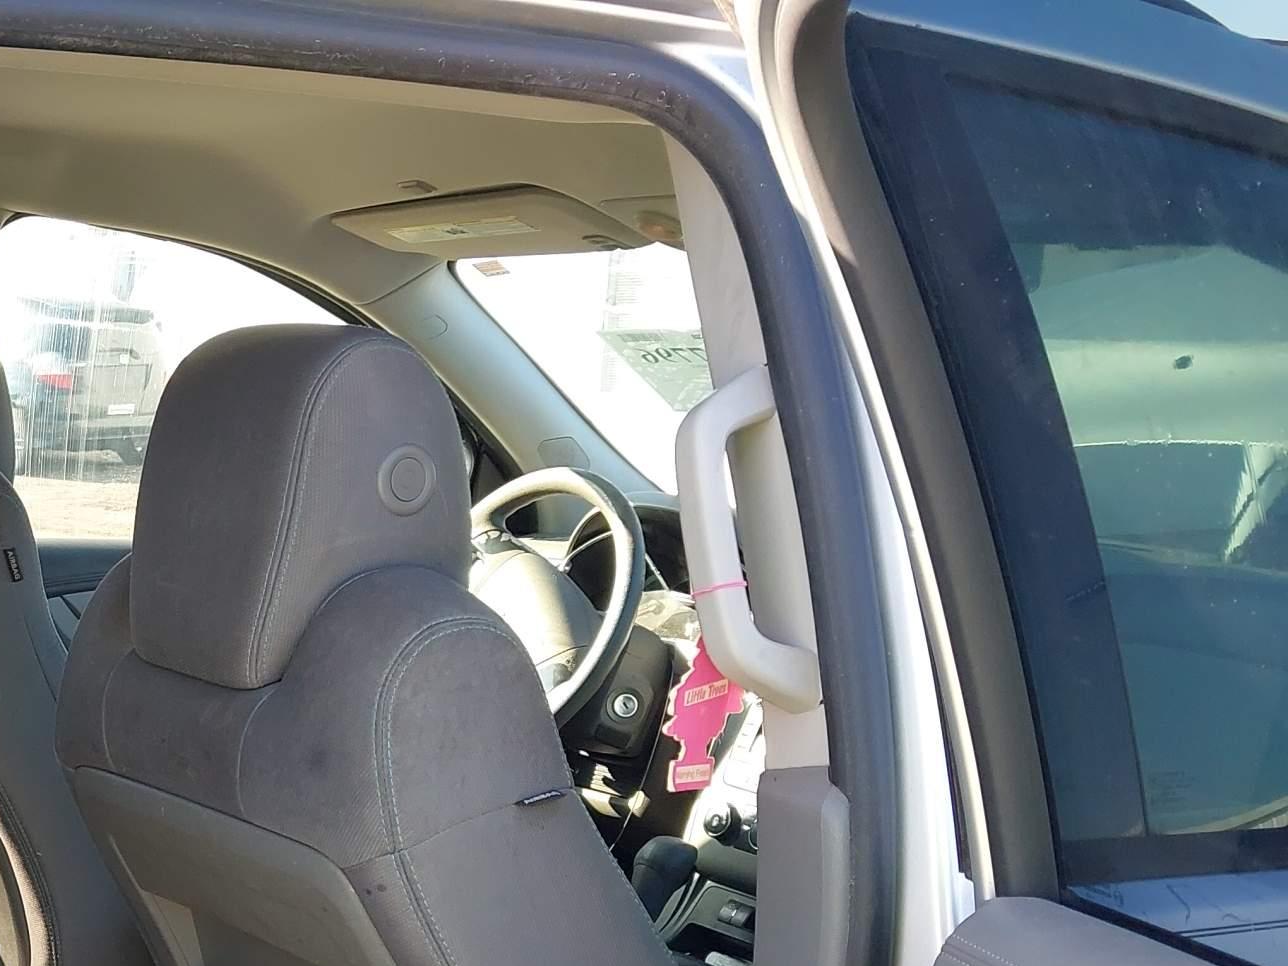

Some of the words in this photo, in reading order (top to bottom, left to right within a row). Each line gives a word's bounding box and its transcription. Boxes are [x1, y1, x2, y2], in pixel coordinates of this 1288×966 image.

[7, 551, 21, 581] AIRBAG
[686, 687, 706, 704] Little
[708, 684, 727, 698] Trees
